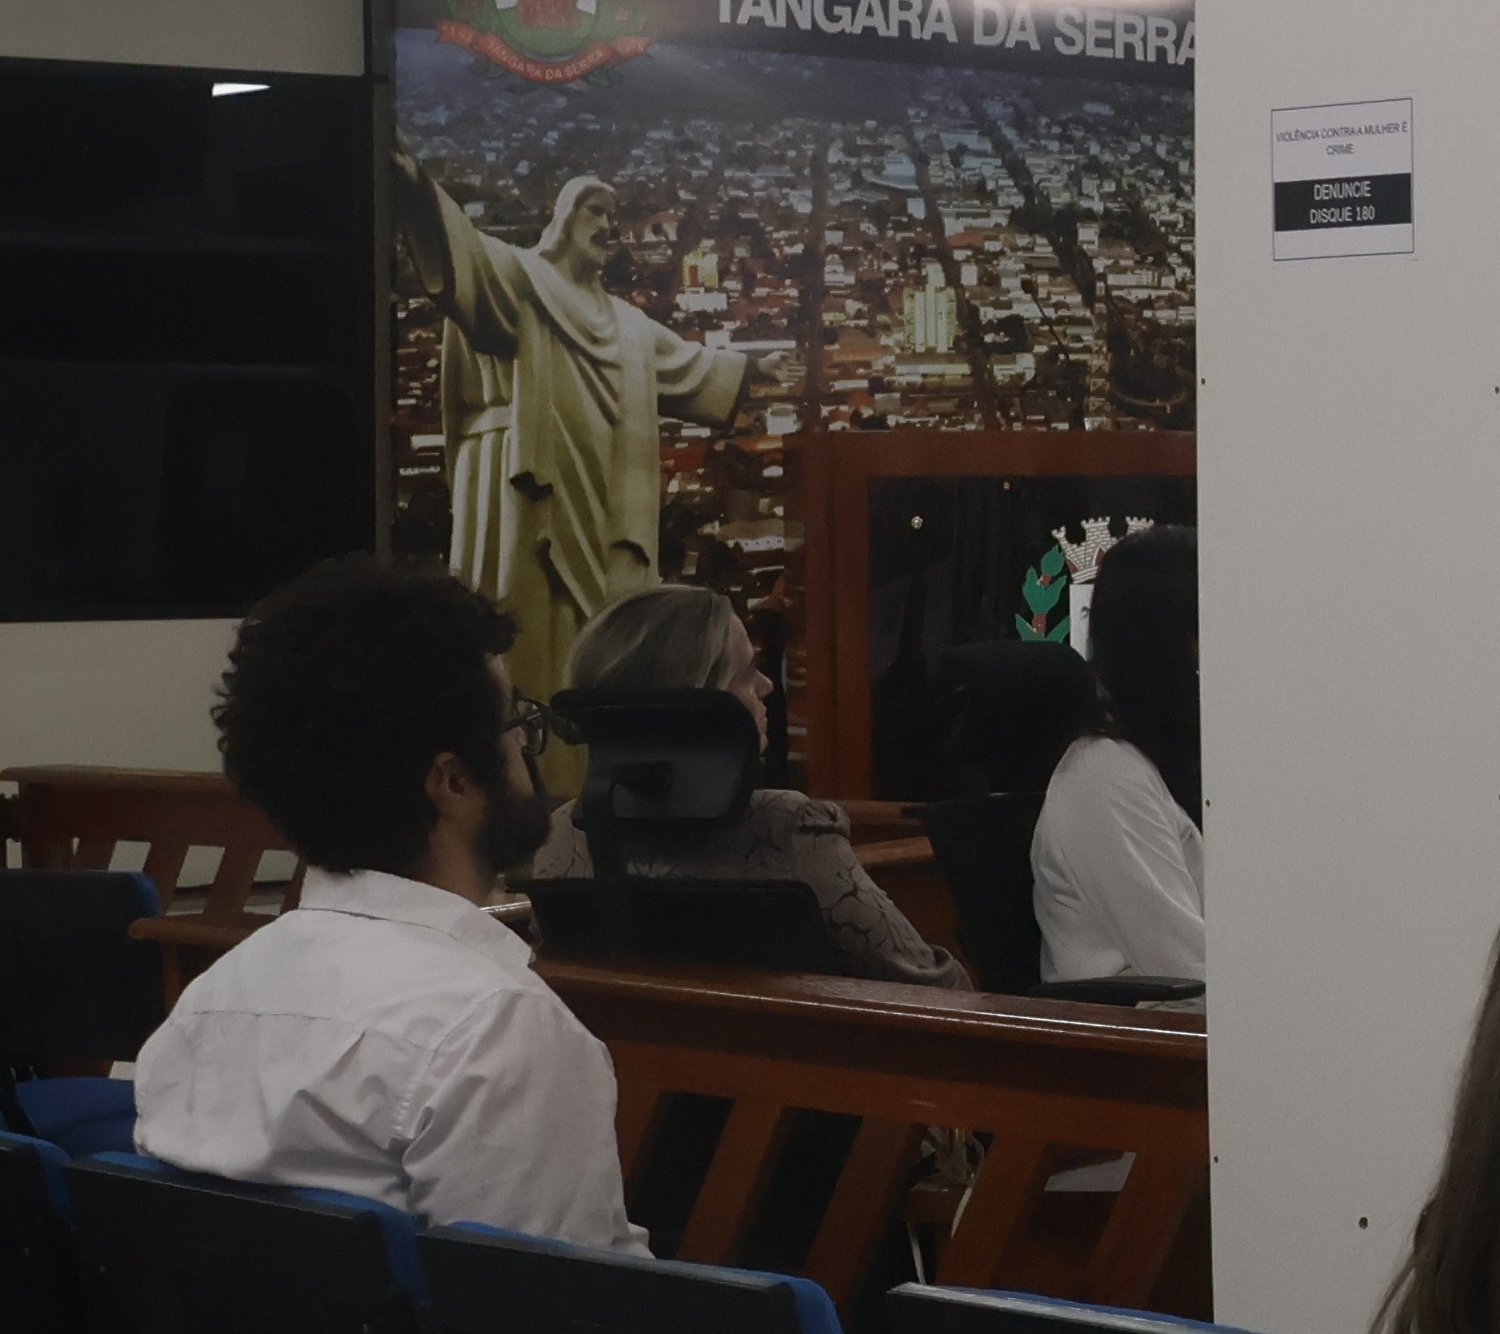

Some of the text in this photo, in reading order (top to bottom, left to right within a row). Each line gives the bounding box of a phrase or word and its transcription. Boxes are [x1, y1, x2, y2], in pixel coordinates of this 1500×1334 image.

[1276, 129, 1320, 143] VIOLÊNCIA
[1322, 128, 1355, 139] CONTRA
[1357, 127, 1364, 135] A
[1364, 123, 1400, 135] MULHER
[1326, 143, 1354, 155] CRIME
[1314, 181, 1372, 201] DENUNCIE
[1310, 205, 1375, 223] DISQUE 180
